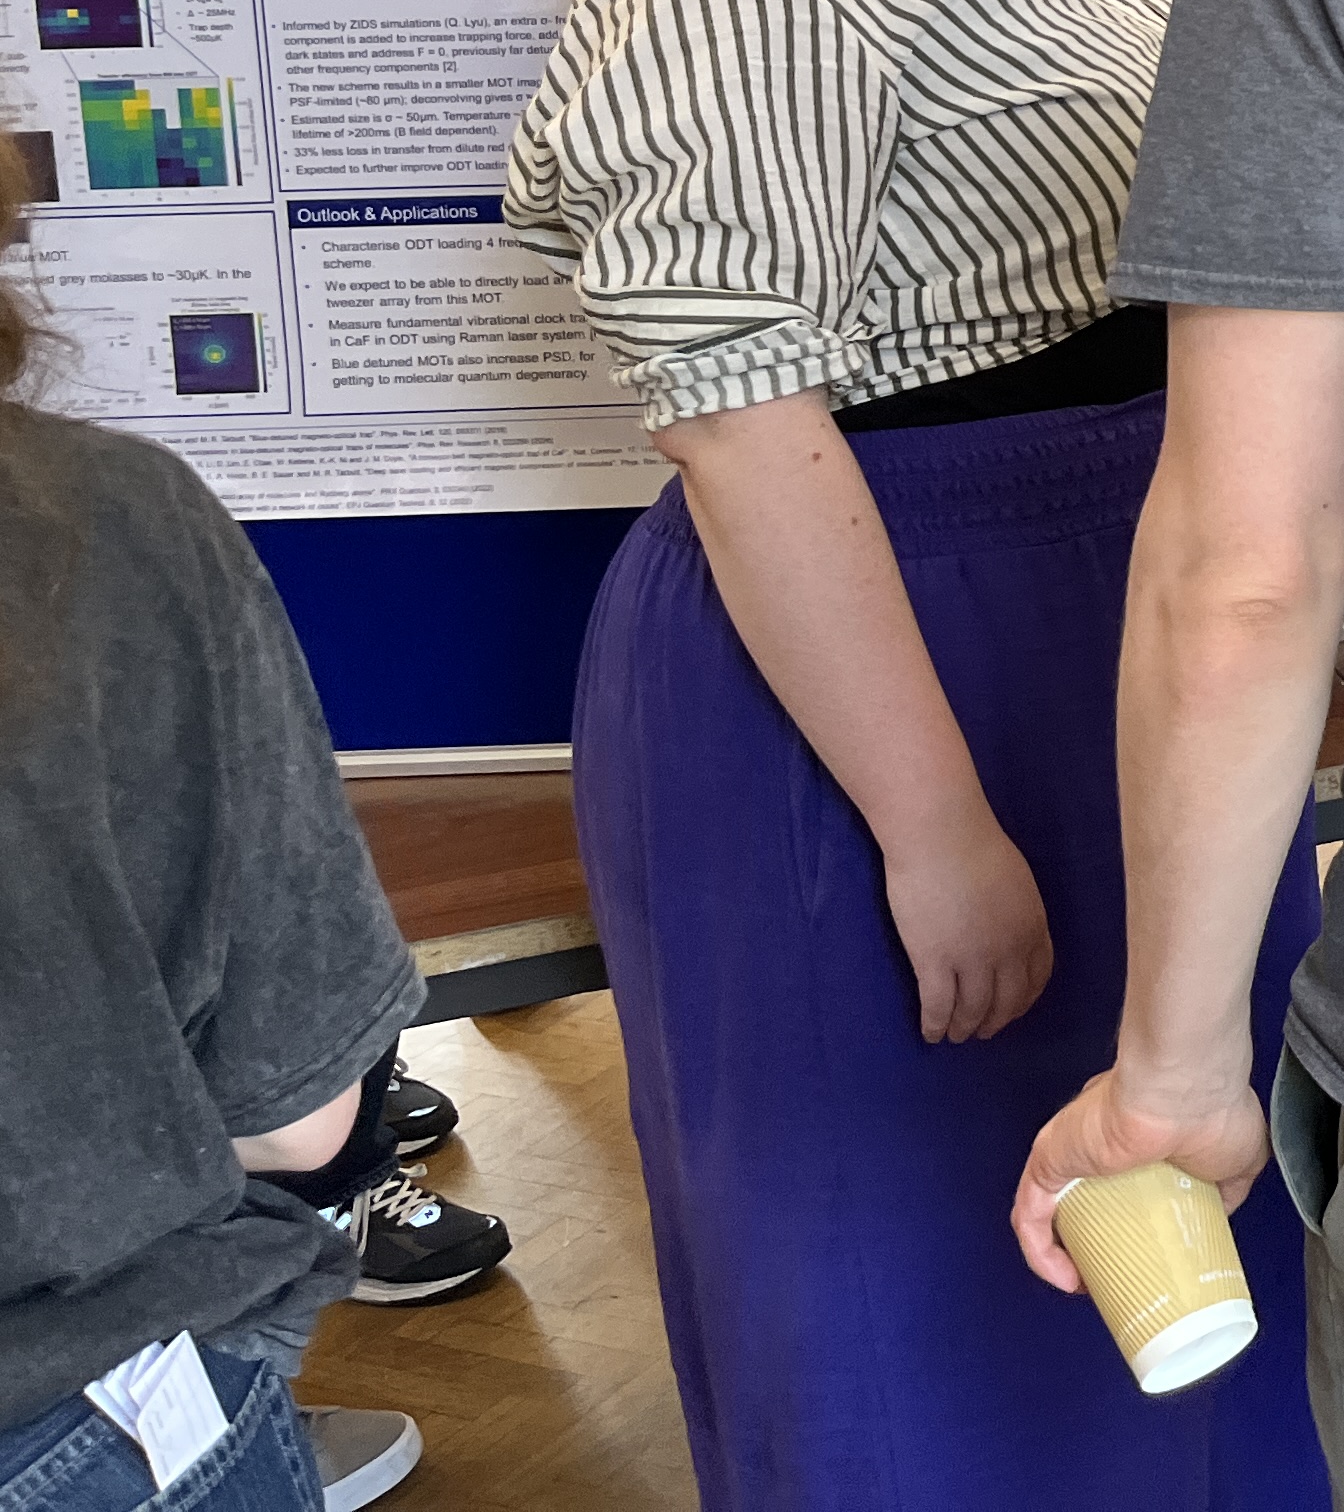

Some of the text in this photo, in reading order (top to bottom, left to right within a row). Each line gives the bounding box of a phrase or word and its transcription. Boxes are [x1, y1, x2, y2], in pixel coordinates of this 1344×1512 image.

[297, 205, 477, 222] Outlook & Applications
[332, 369, 590, 388] getting to molecular quantum degeneracy.
